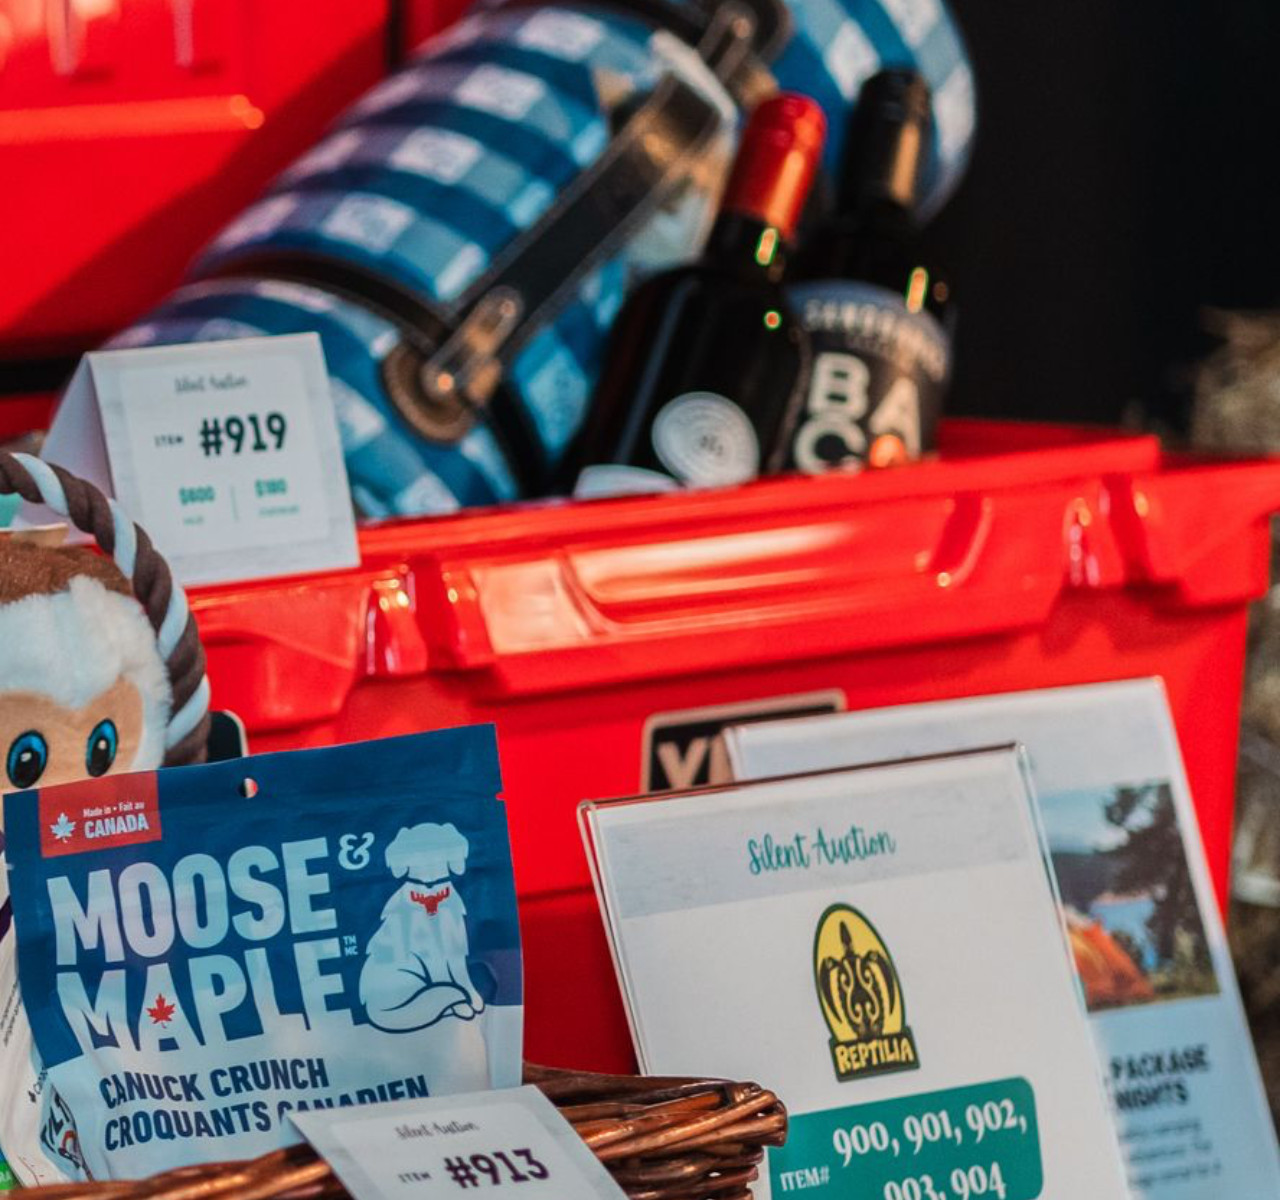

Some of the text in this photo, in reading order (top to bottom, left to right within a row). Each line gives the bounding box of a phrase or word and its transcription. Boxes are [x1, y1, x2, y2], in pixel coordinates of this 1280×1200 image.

[200, 412, 287, 456] #919
[83, 808, 102, 818] Made
[84, 813, 149, 839] CANADA
[746, 825, 895, 874] Silent Auction
[47, 831, 375, 965] MOOSE &
[56, 937, 356, 1053] MAPLE
[835, 1037, 914, 1073] REPTILIA
[100, 1058, 330, 1109] CANUCK CRUNCH
[105, 1101, 271, 1151] CROQUANTS
[833, 1098, 1028, 1167] 900, 901, 902,
[399, 1148, 549, 1189] ITEM #913
[780, 1165, 830, 1192] ITEM#
[950, 1161, 1006, 1200] 904
